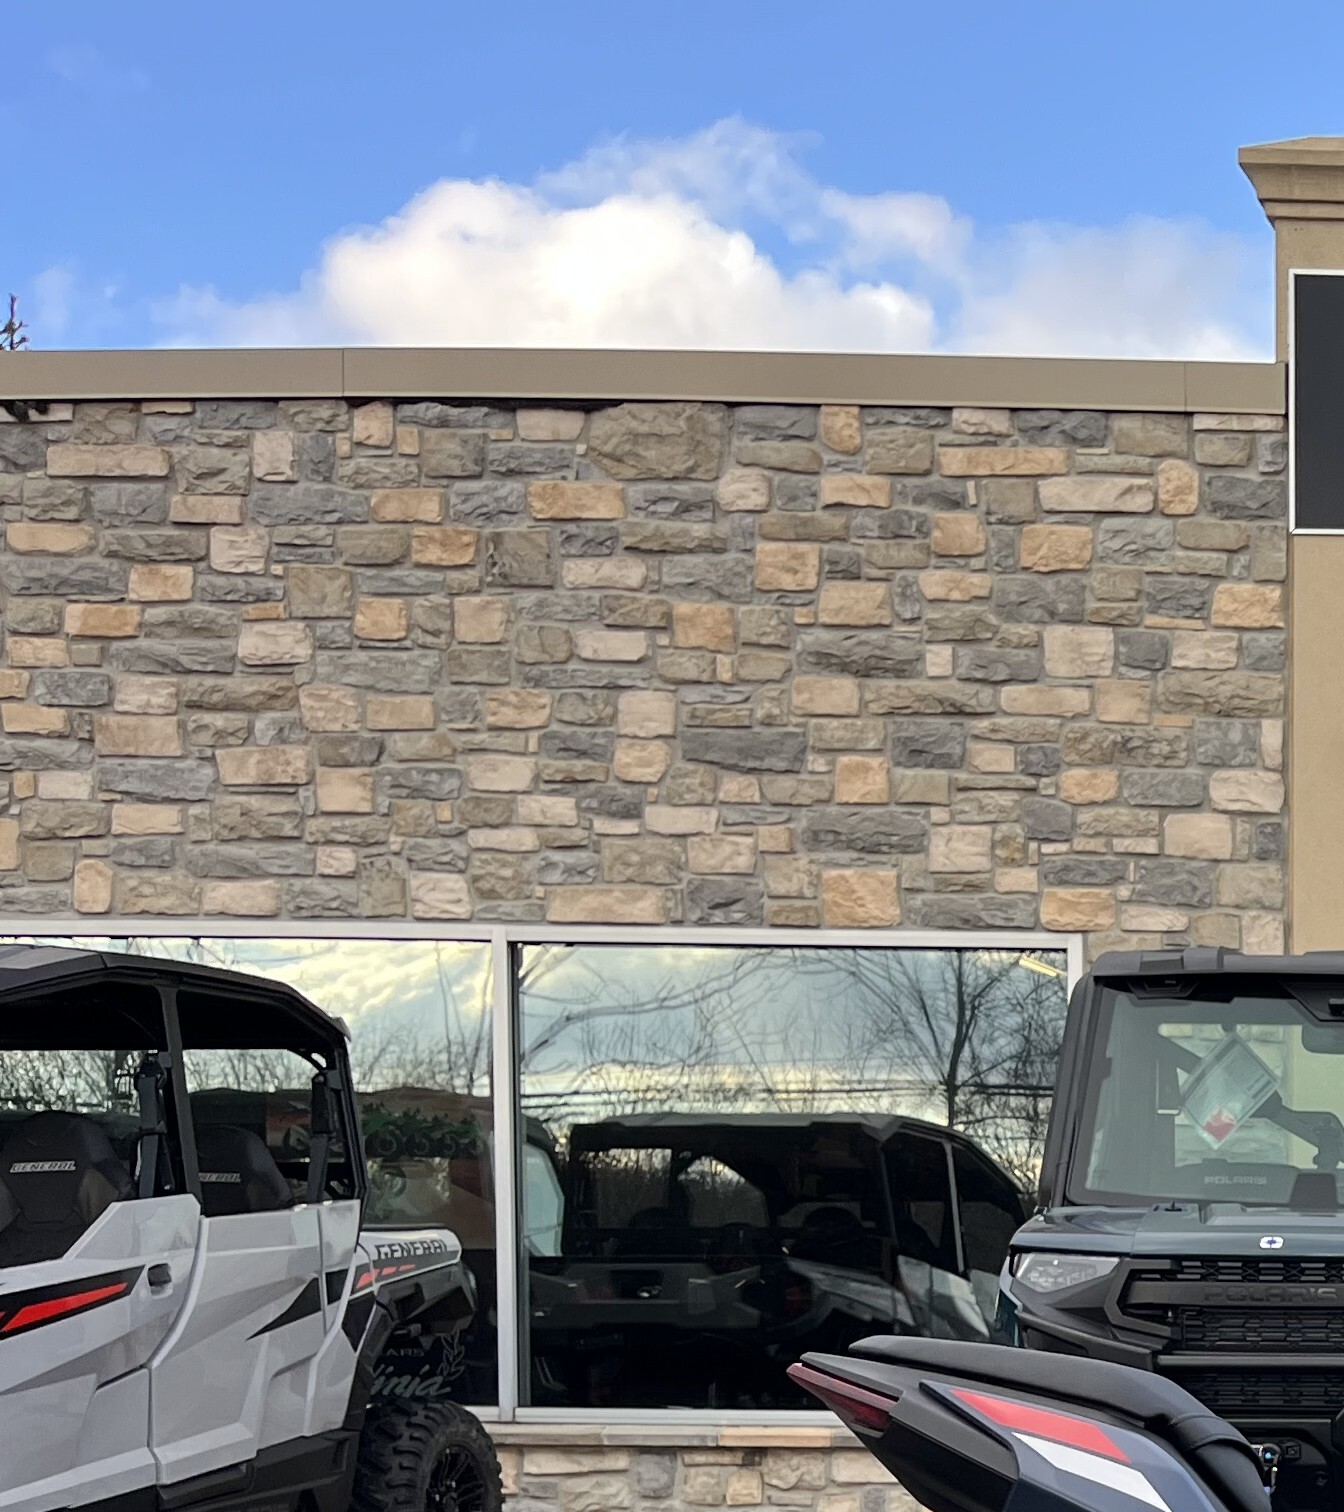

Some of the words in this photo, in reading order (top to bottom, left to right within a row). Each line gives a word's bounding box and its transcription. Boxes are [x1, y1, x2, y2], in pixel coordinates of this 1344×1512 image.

[10, 1160, 76, 1173] GENERAL
[1204, 1175, 1268, 1185] POLARIS
[1203, 1285, 1337, 1302] POLARIS
